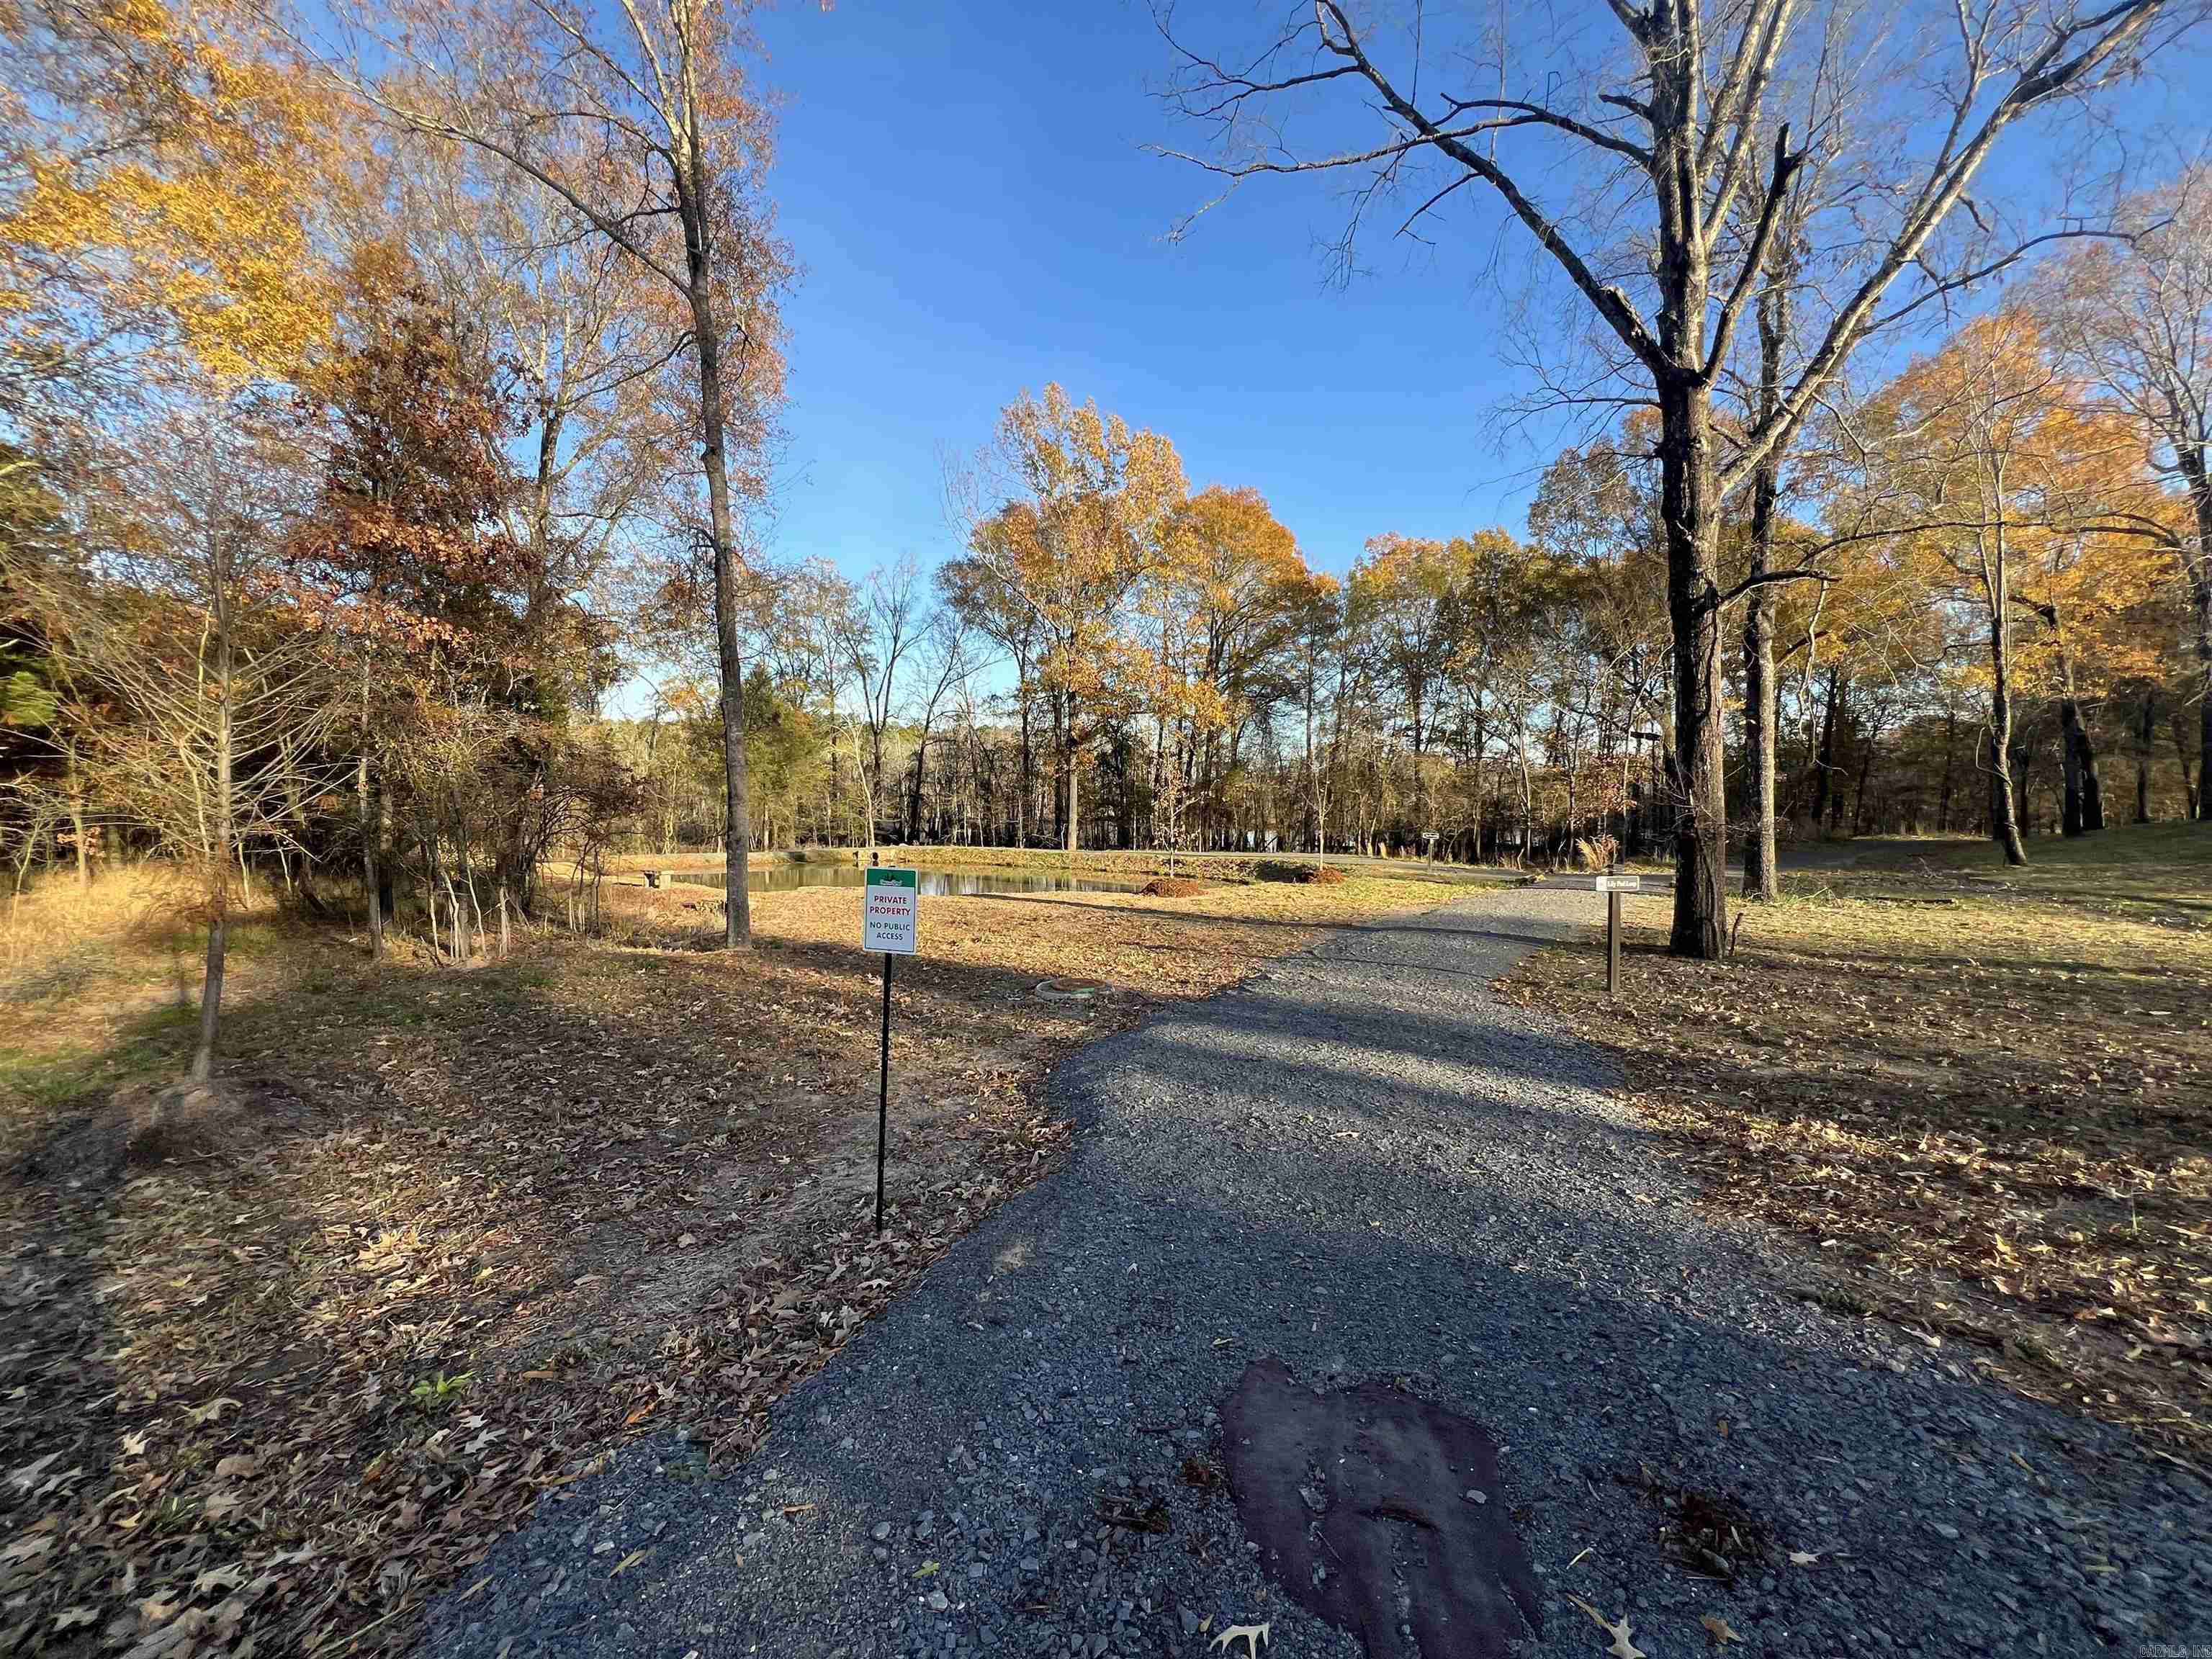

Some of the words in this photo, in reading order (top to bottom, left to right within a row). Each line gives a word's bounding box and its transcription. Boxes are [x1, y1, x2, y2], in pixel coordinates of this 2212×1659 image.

[874, 895, 907, 904] PRIVATE
[870, 907, 911, 916] PROPERTY
[884, 922, 910, 931] PUBLIC
